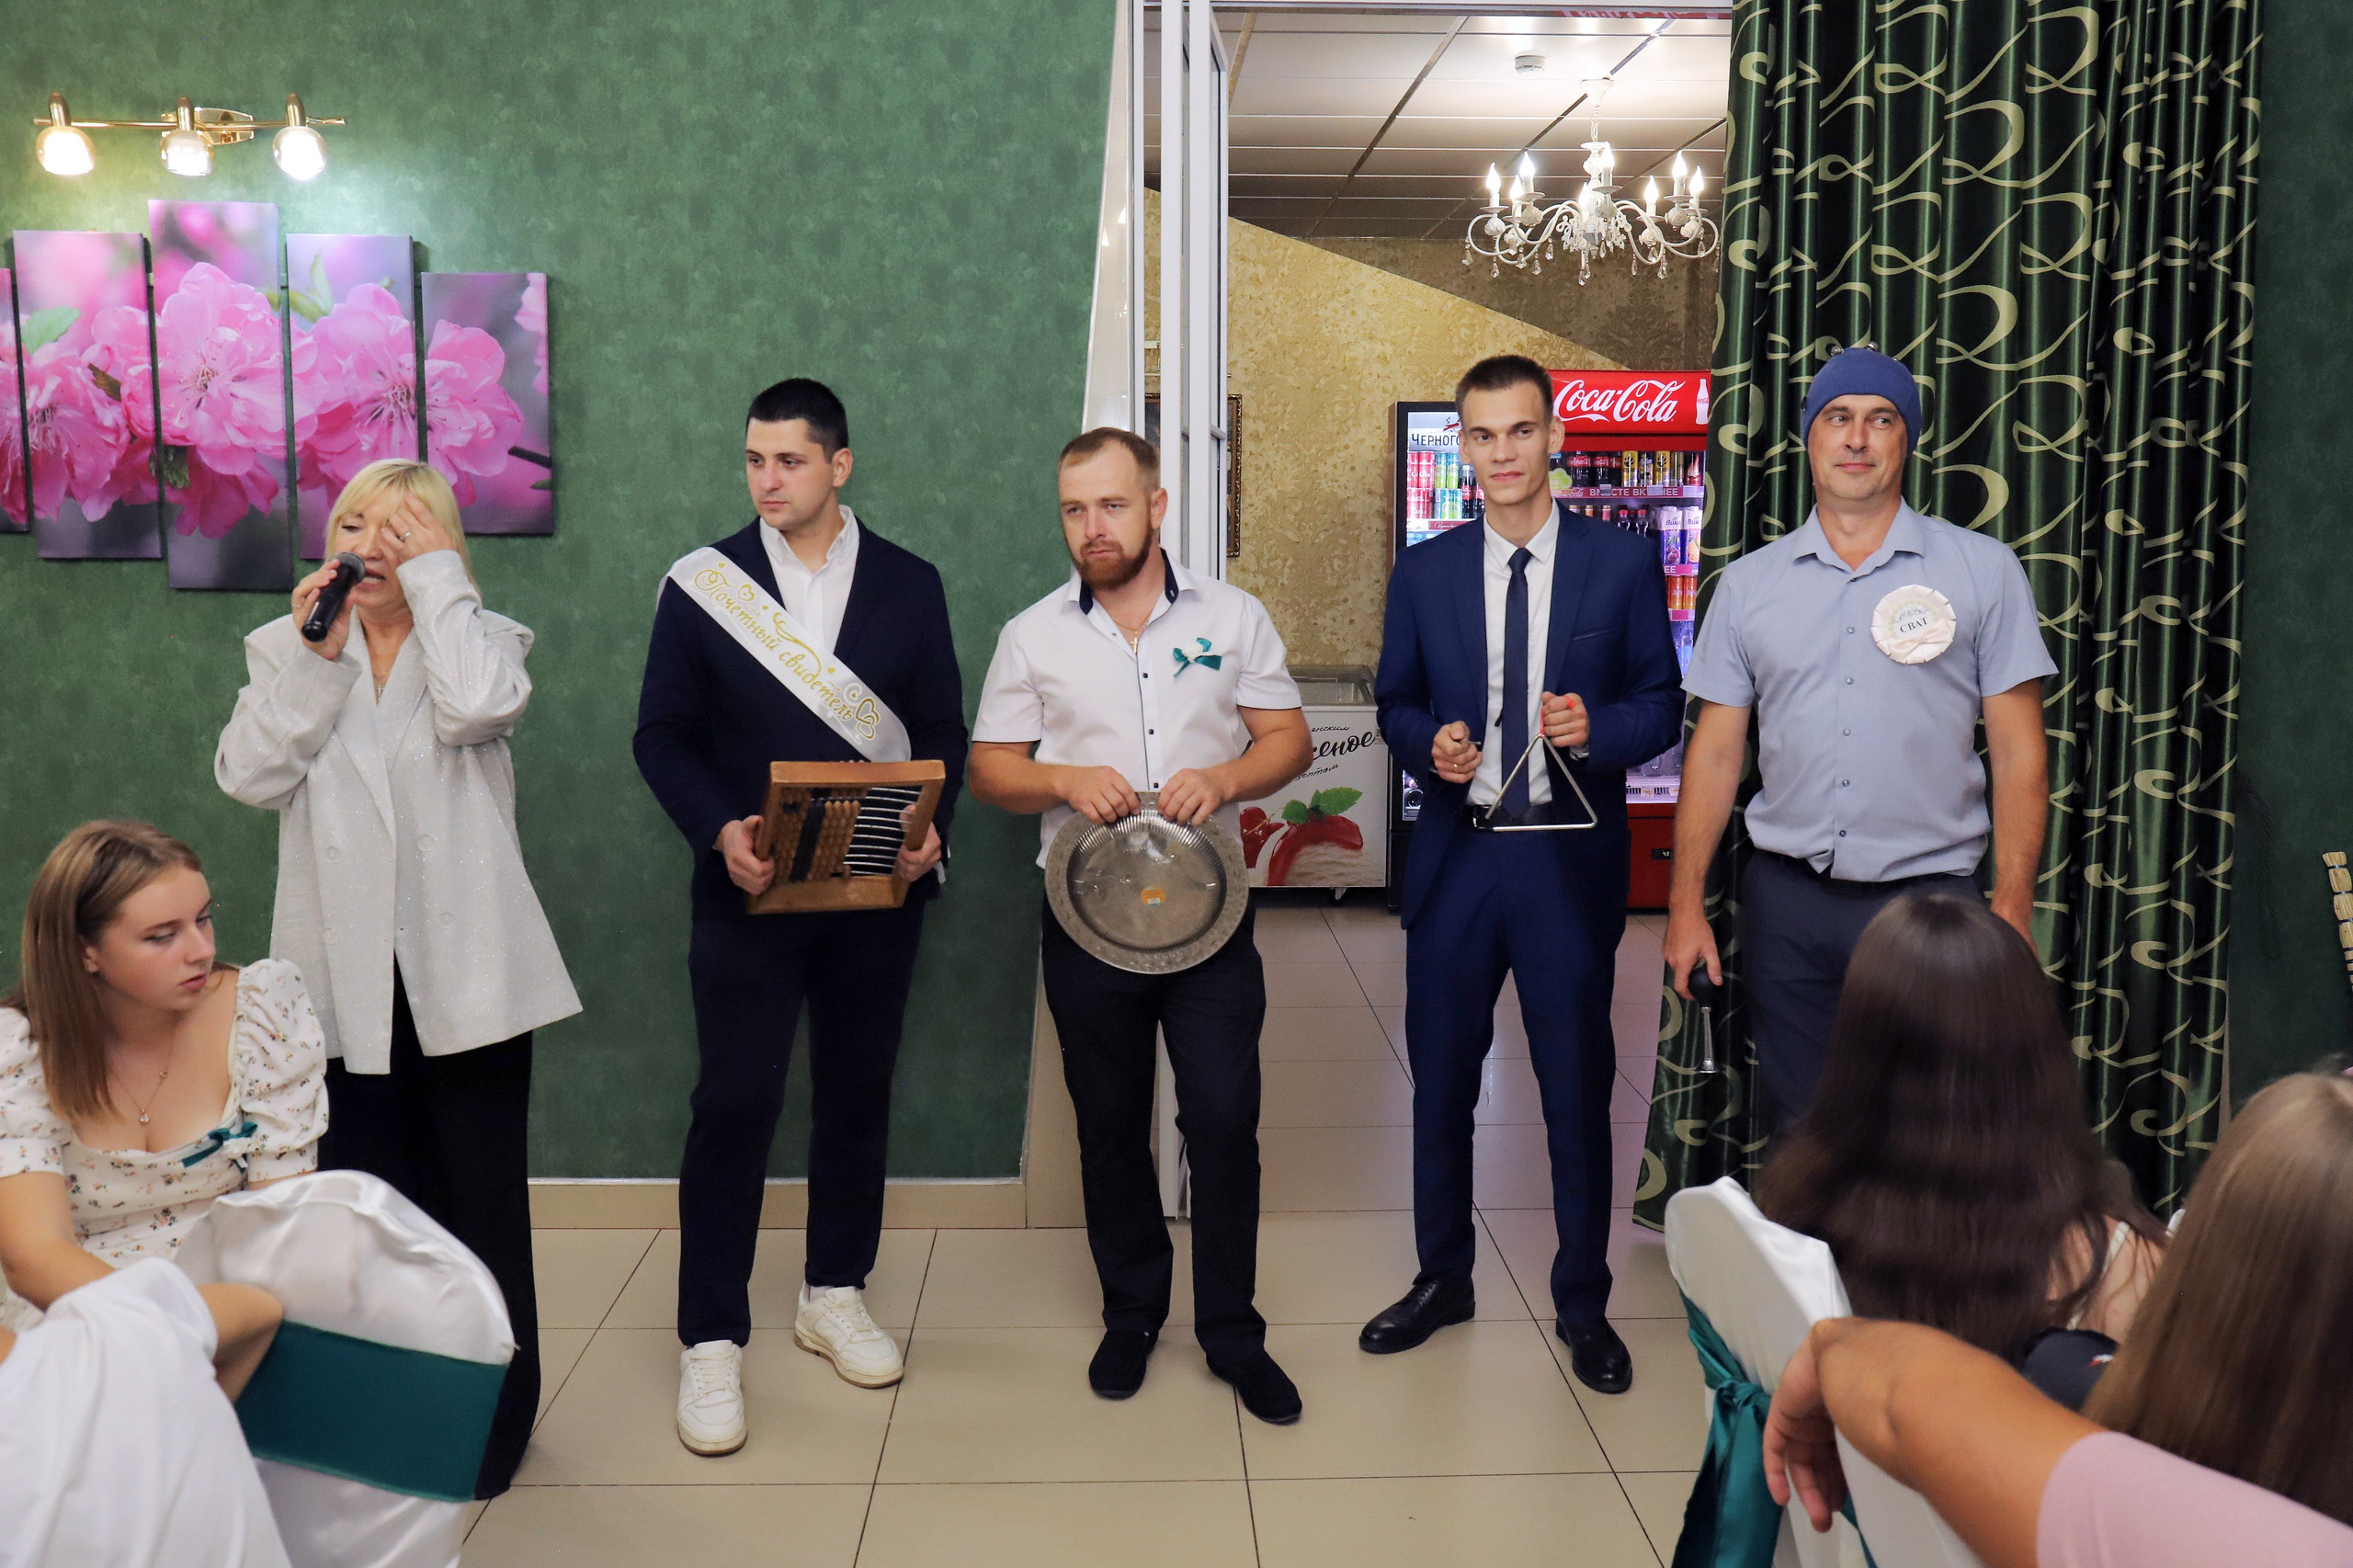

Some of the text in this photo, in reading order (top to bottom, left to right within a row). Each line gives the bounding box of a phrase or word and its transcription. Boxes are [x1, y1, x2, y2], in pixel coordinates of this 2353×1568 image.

[1553, 380, 1686, 423] Coca-Cola
[1900, 617, 1927, 632] СВАТ
[773, 613, 853, 722] свидетель
